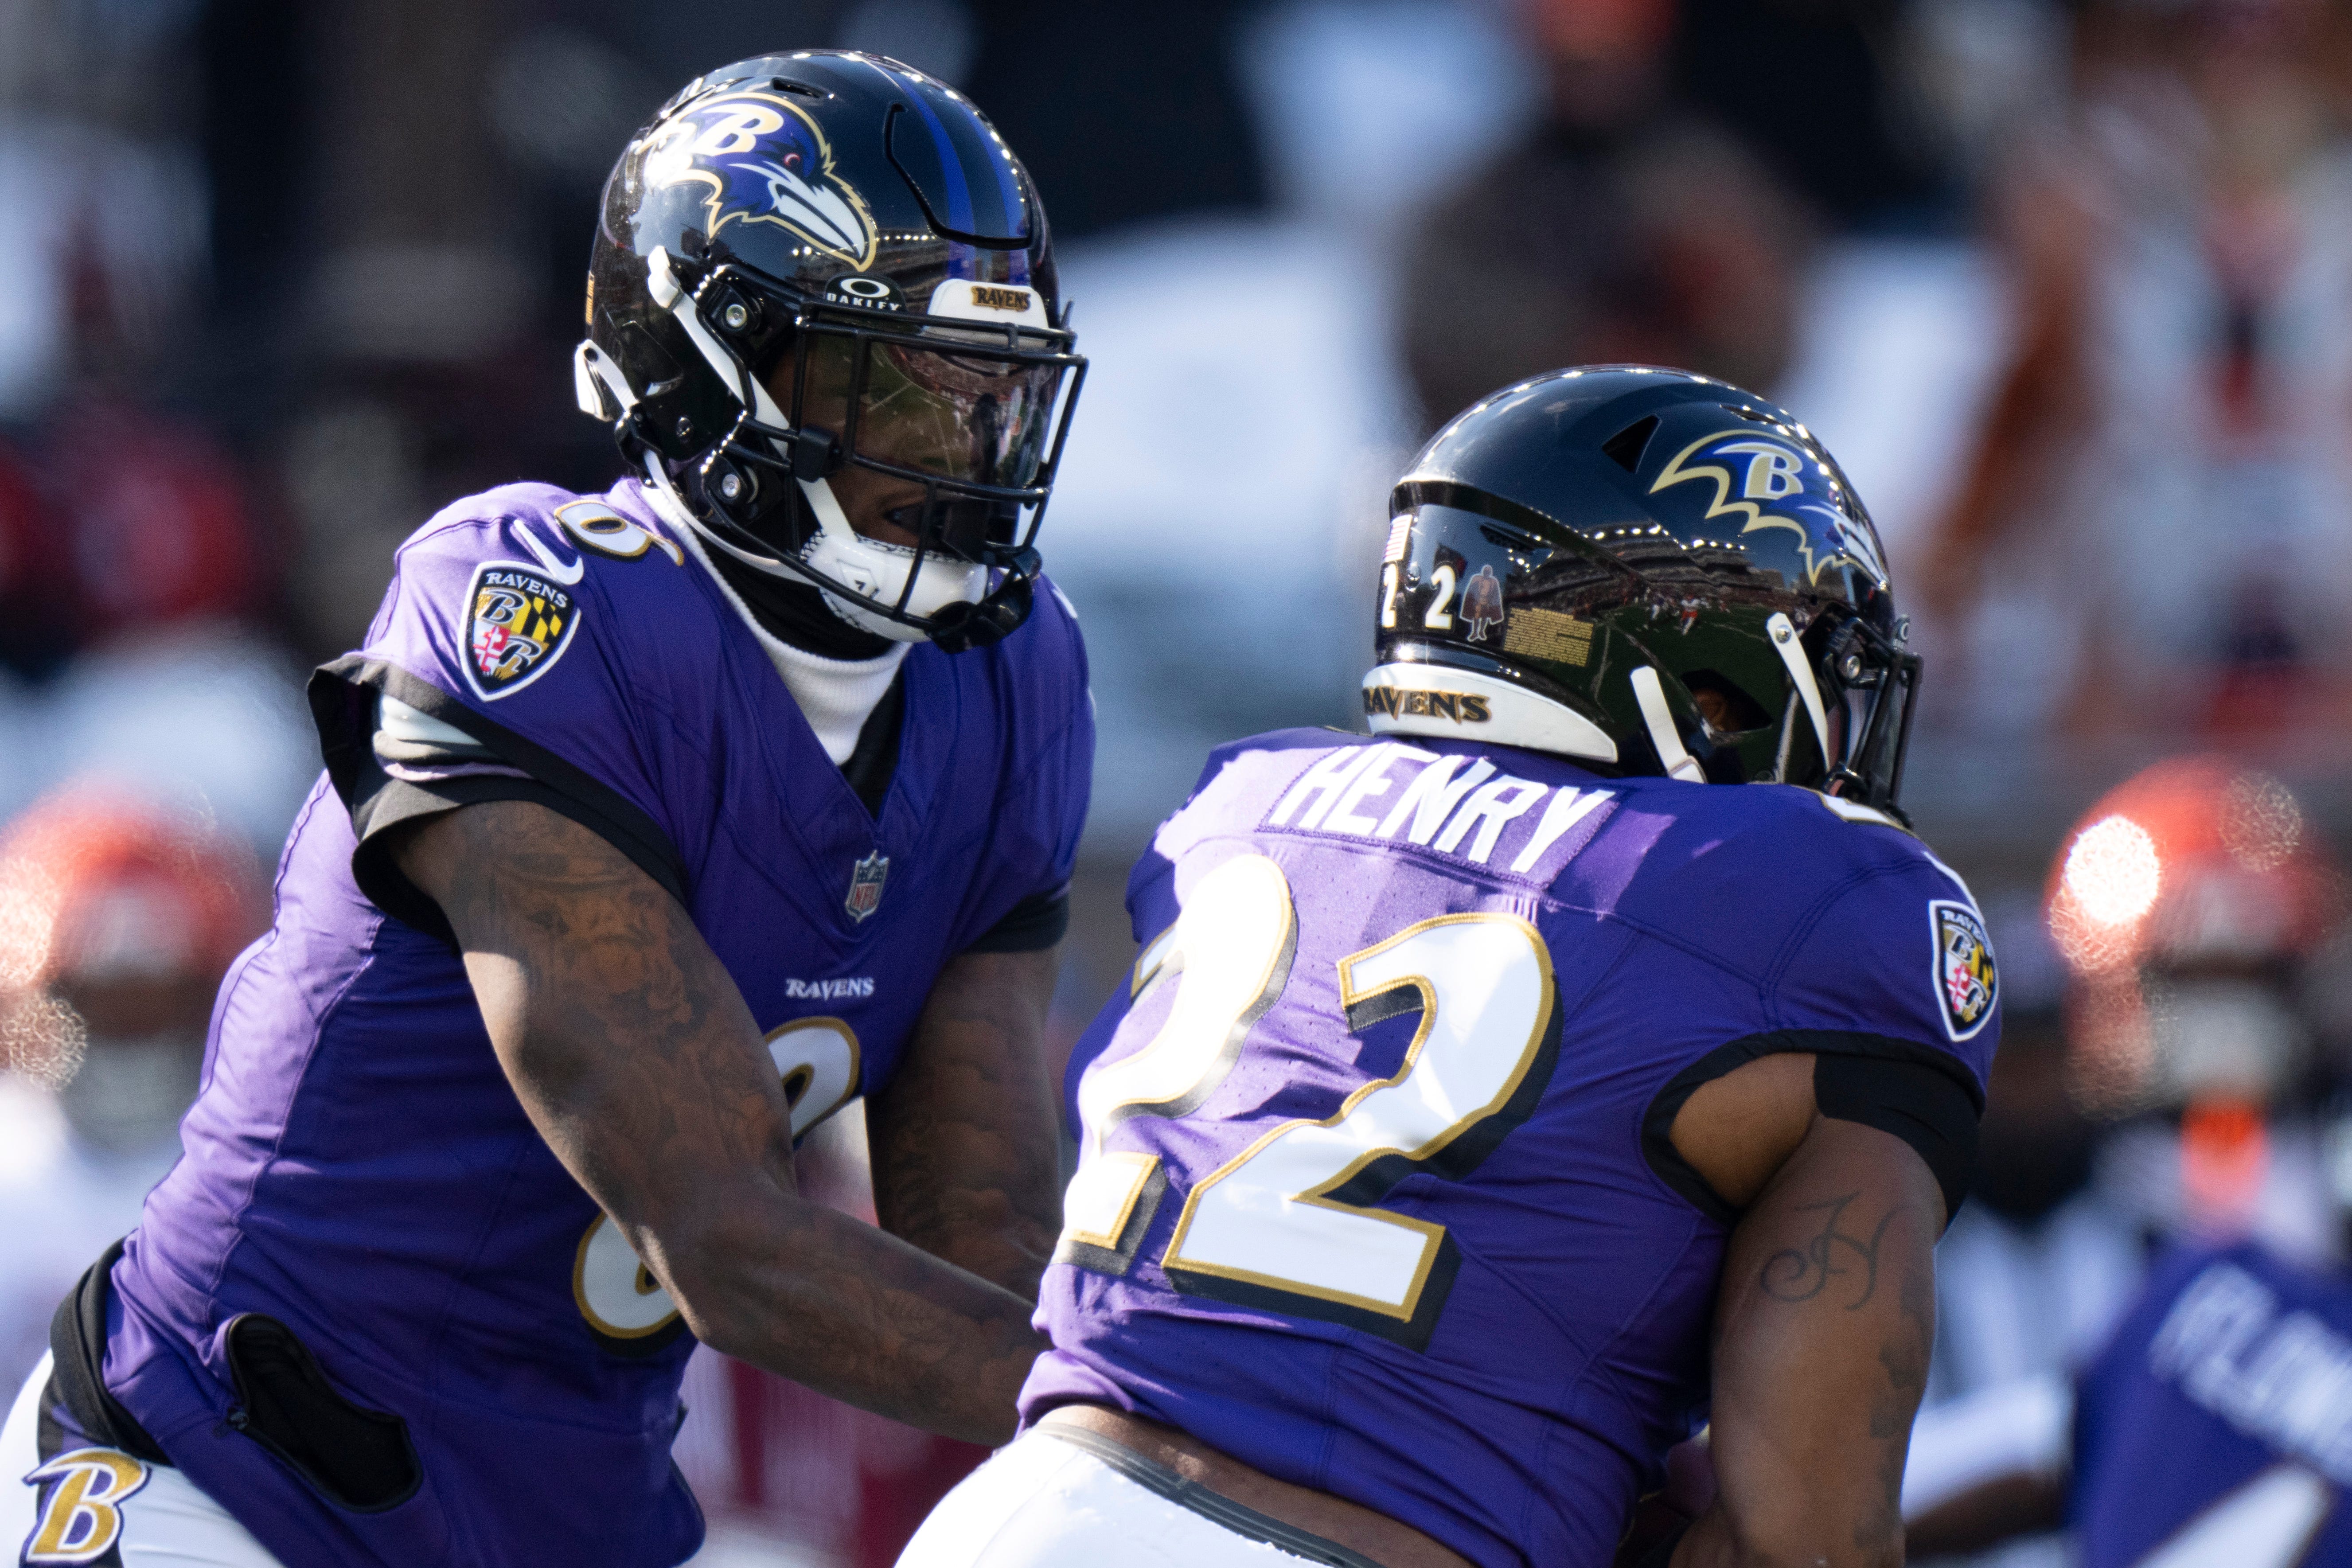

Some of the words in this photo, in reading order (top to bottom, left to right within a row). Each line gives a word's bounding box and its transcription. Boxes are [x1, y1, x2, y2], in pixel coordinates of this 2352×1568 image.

[971, 286, 1031, 312] RAVENS
[1712, 442, 1804, 500] B
[486, 572, 568, 608] RAVENS
[1268, 742, 1616, 873] HENRY
[785, 977, 875, 1001] RAVENS
[1050, 853, 1562, 1352] 22
[22, 1446, 152, 1565] B
